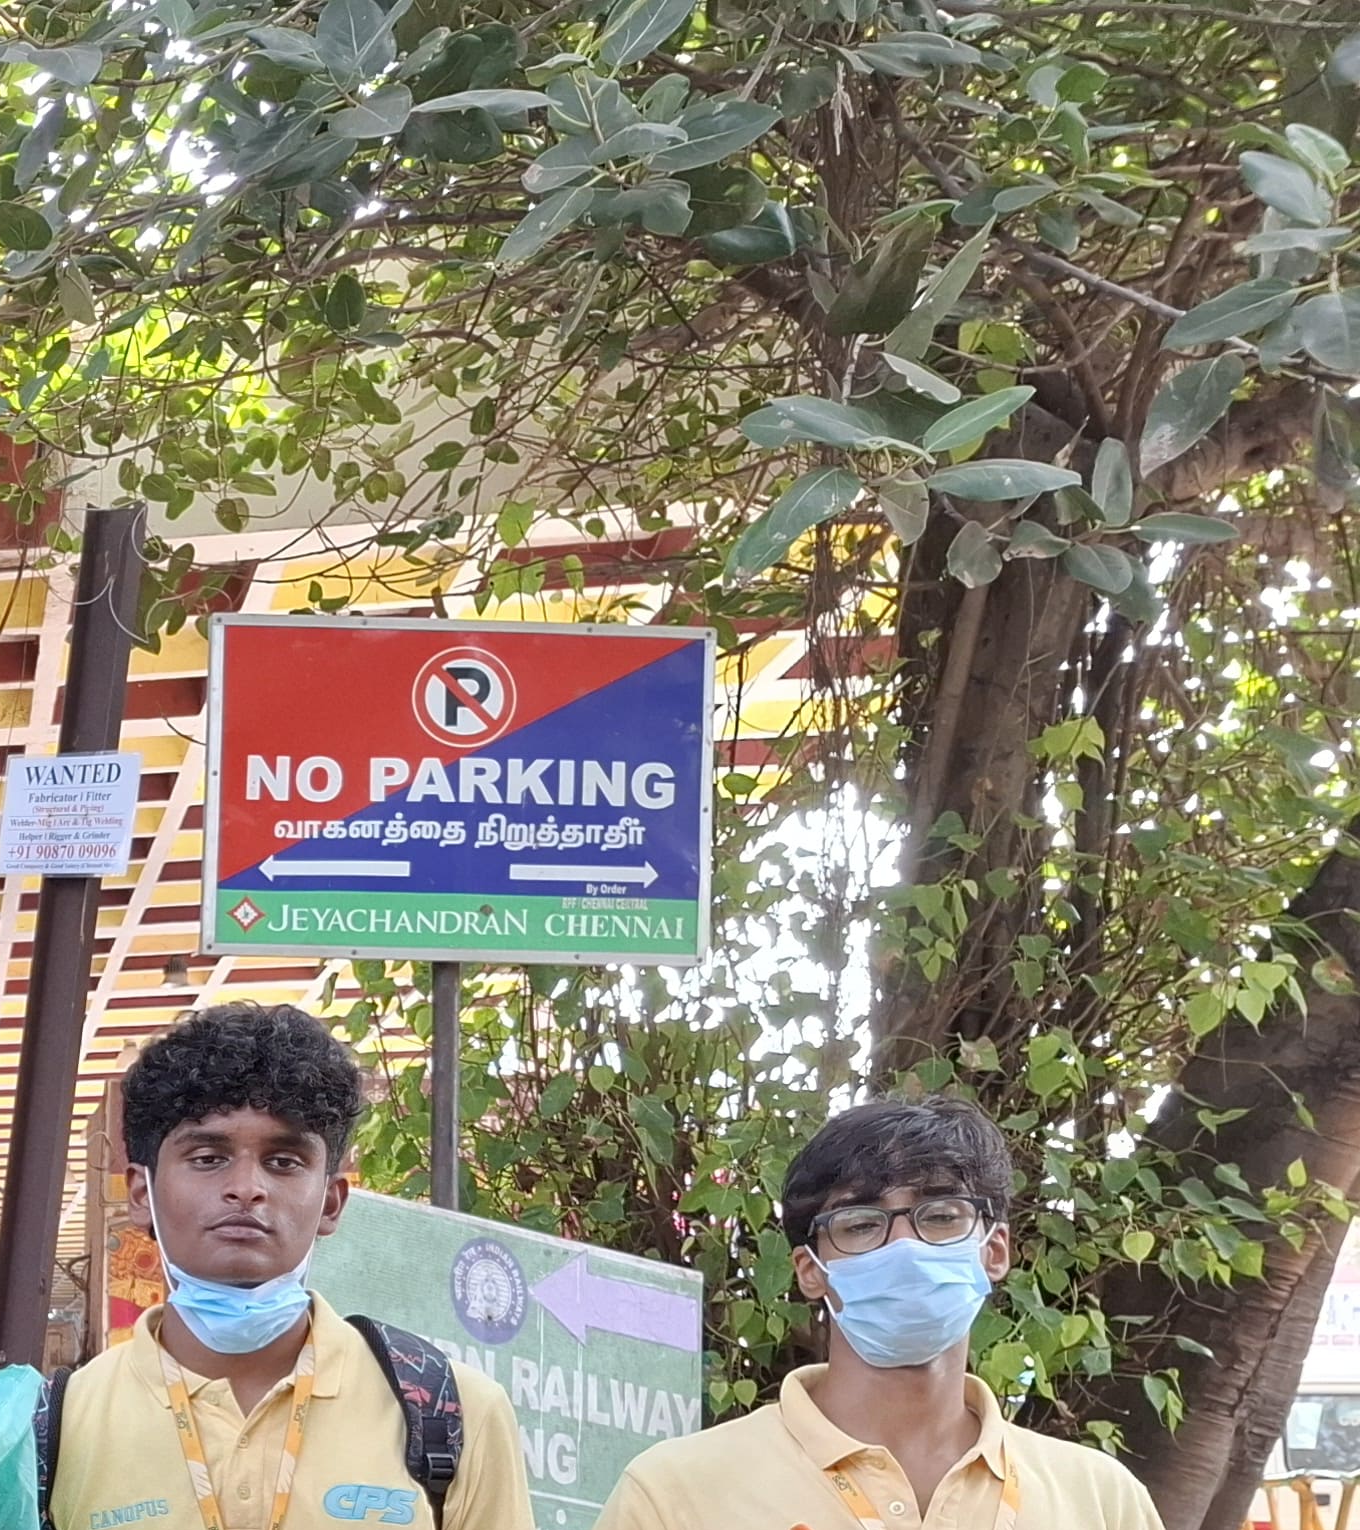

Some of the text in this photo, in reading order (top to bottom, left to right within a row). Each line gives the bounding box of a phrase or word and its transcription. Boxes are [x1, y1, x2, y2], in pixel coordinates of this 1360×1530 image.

[25, 762, 121, 786] WANTED
[245, 754, 677, 810] NO PARKING
[28, 791, 111, 803] Fabricator Fitter
[273, 812, 645, 851] வாகனத்தை நிறுத்தாதீர்
[8, 845, 30, 859] +91
[36, 845, 75, 859] 90870
[586, 884, 627, 896] By Order
[267, 902, 685, 941] JEYACHANDRAN CHENNAI
[512, 1356, 701, 1440] RAILWAY
[323, 1484, 418, 1526] CPS
